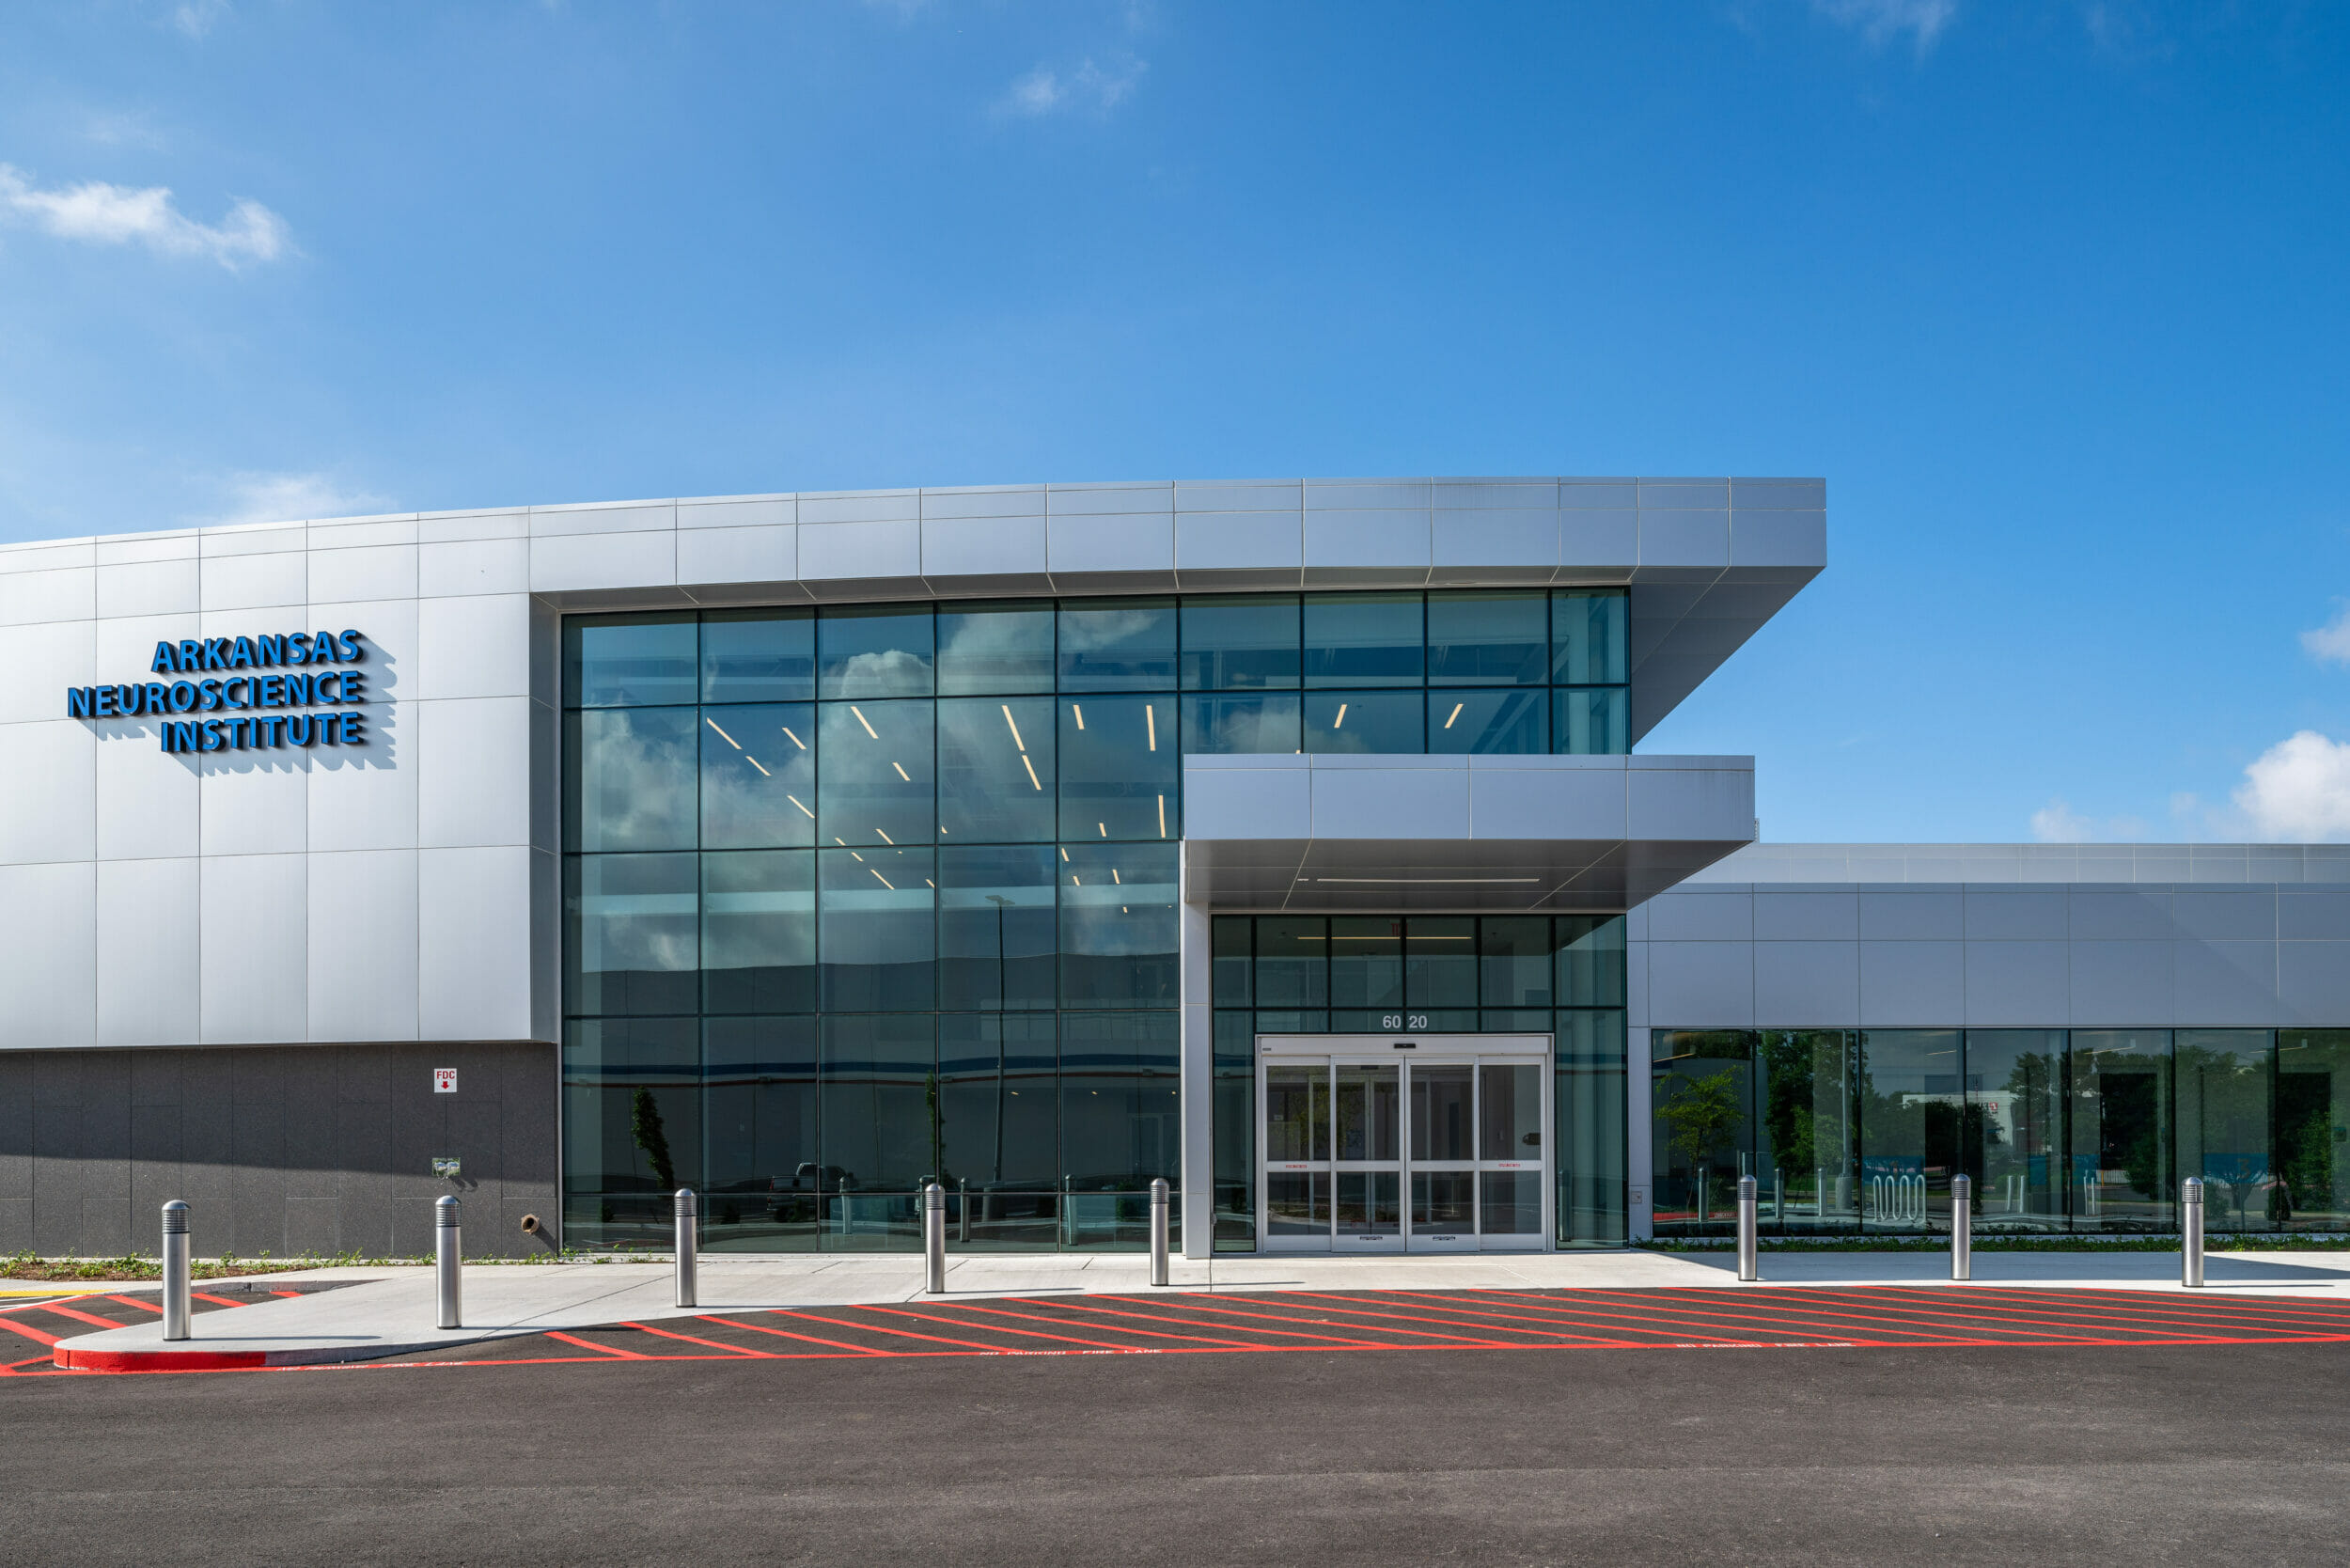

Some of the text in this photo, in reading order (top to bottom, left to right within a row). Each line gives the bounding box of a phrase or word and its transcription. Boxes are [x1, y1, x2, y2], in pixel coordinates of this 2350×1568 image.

[151, 630, 361, 672] ARKANSAS
[68, 670, 361, 718] NEUROSCIENCE
[161, 711, 361, 753] INSTITUTE
[436, 1070, 456, 1079] FDC
